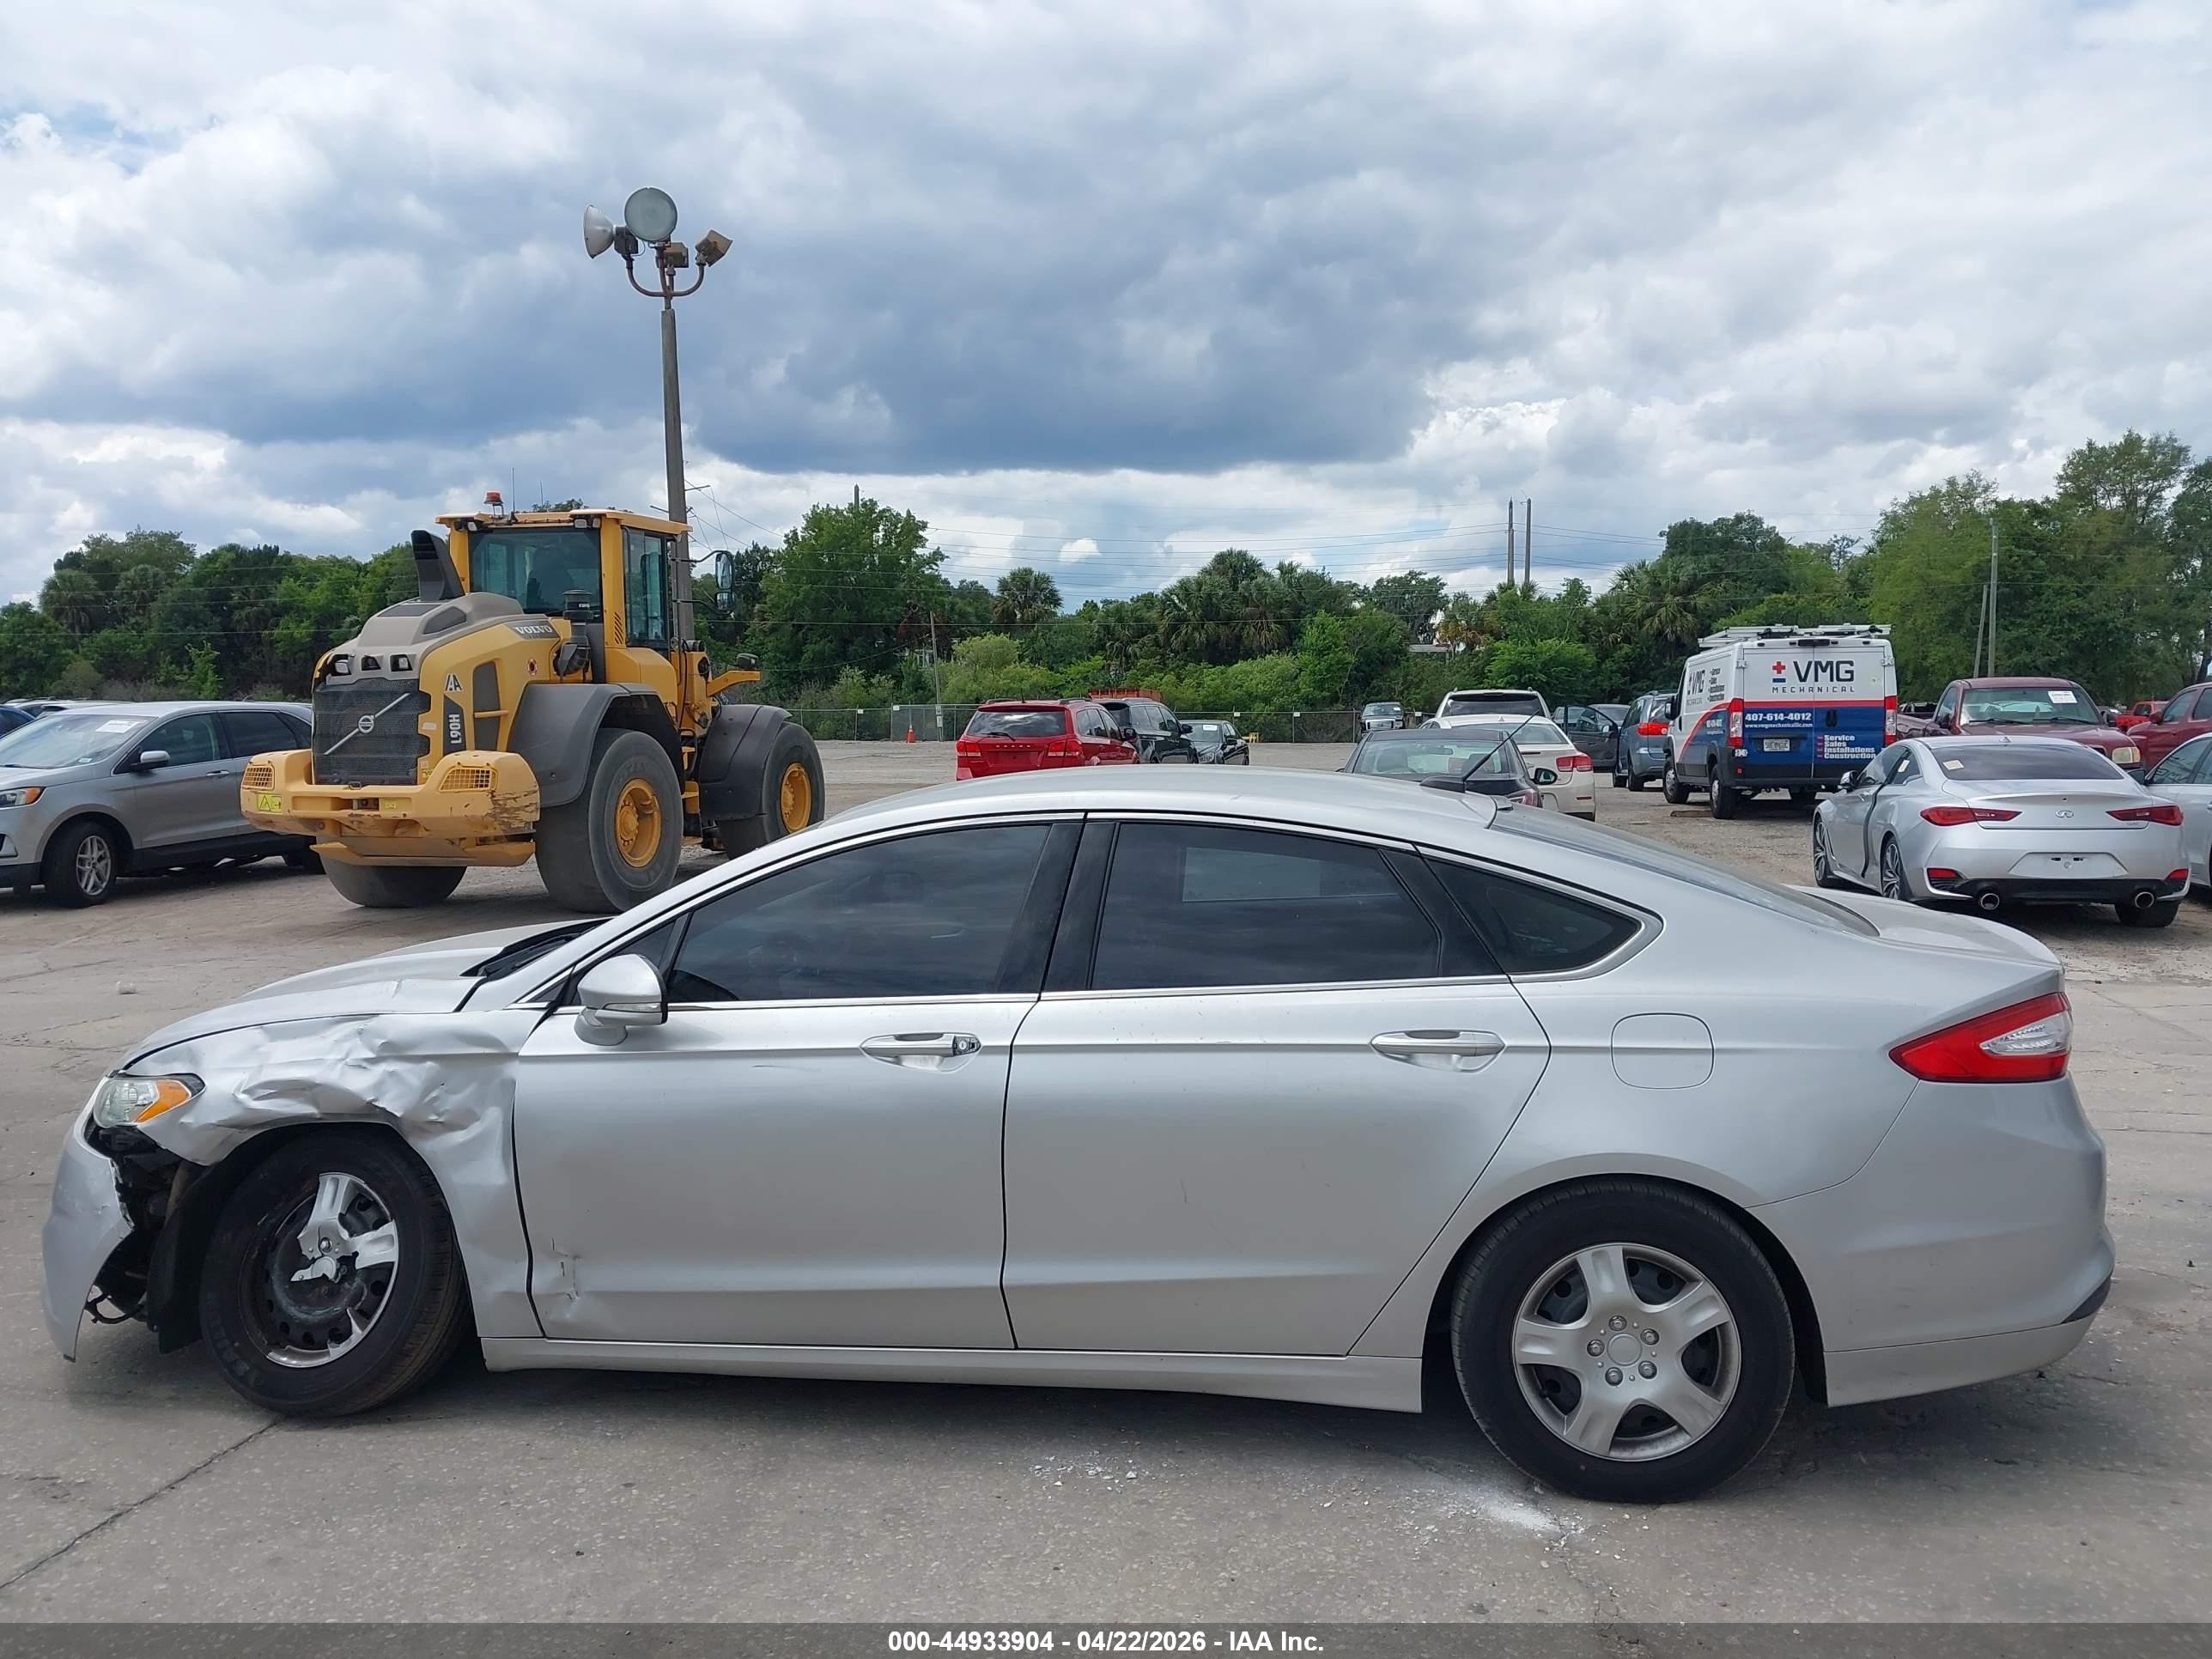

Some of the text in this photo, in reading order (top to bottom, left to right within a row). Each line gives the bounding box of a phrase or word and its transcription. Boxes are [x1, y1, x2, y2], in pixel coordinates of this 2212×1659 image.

[515, 624, 552, 635] VOLVO
[1793, 660, 1854, 683] VMG
[1745, 713, 1812, 721] 407-614-4012
[448, 714, 462, 744] L90H
